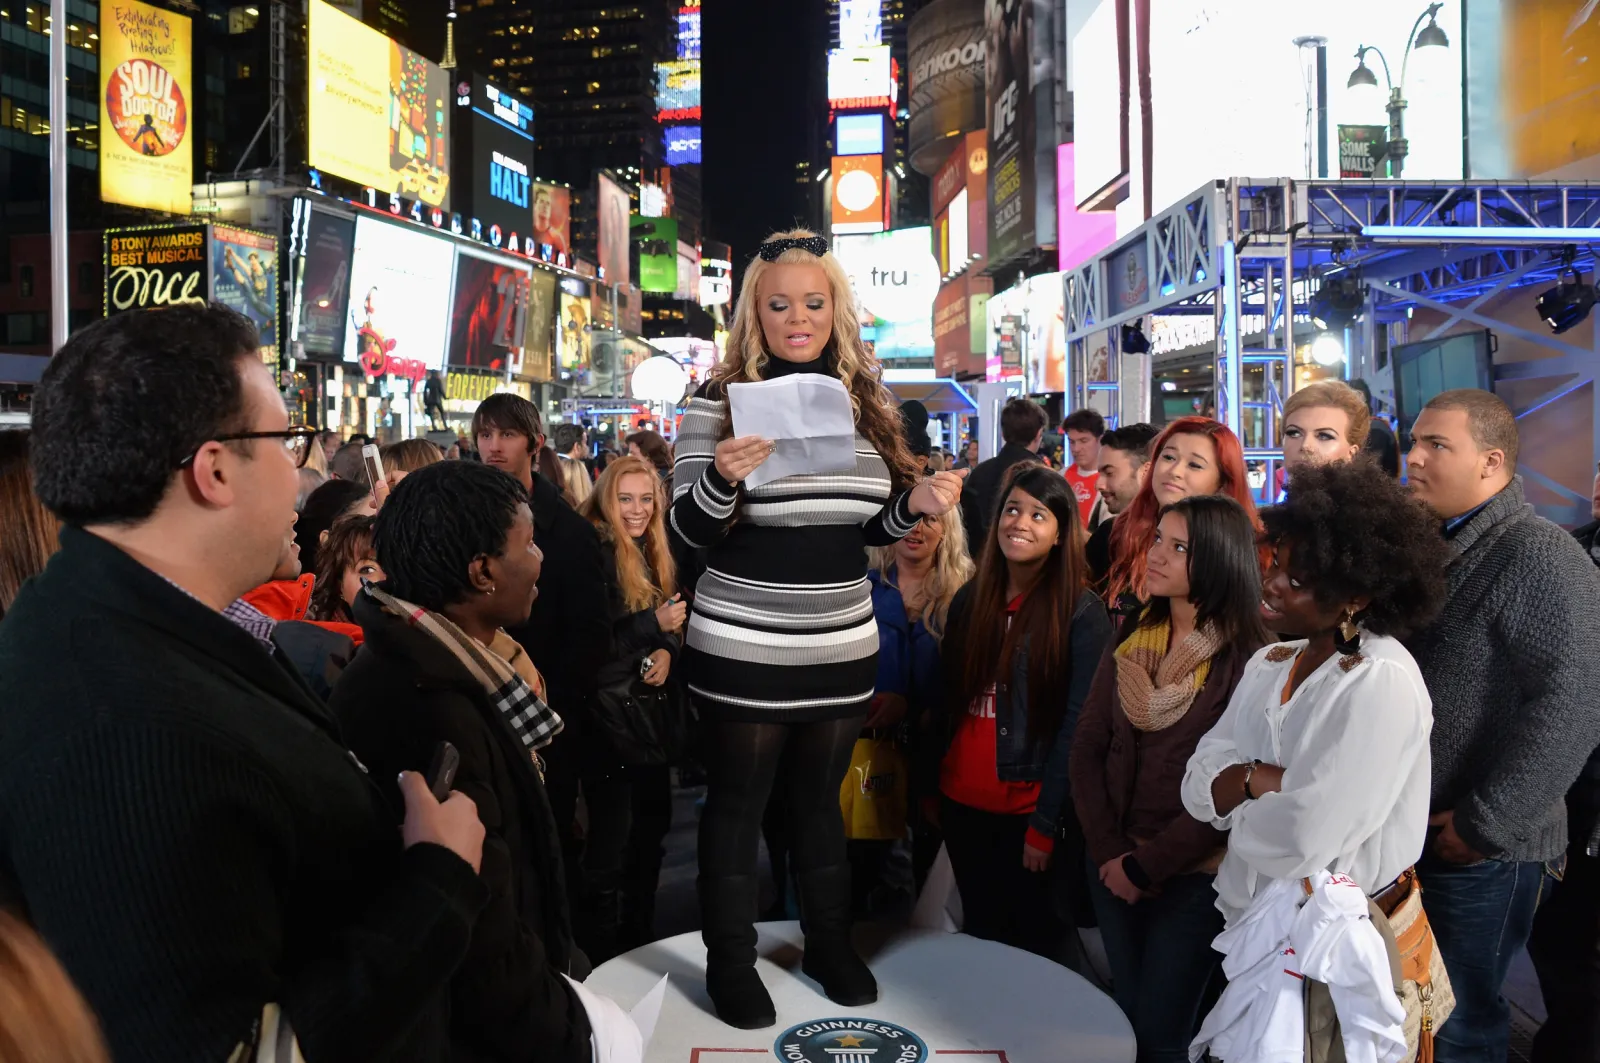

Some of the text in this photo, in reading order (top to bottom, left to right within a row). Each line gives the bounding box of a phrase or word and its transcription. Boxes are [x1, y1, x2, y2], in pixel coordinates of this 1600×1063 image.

[116, 60, 174, 102] SOUL
[120, 96, 178, 125] DOCTOR
[831, 96, 890, 109] TOSHIBA
[1341, 141, 1371, 157] SOME
[1341, 156, 1376, 172] WALLS
[489, 161, 530, 208] HALT
[111, 237, 120, 251] 8
[120, 235, 153, 251] TONY
[152, 232, 203, 248] AWARDS
[451, 212, 577, 270] BROADWA
[111, 249, 204, 267] BEST MUSICAL
[446, 372, 498, 401] FOREVER
[795, 1020, 904, 1039] GUINNESS
